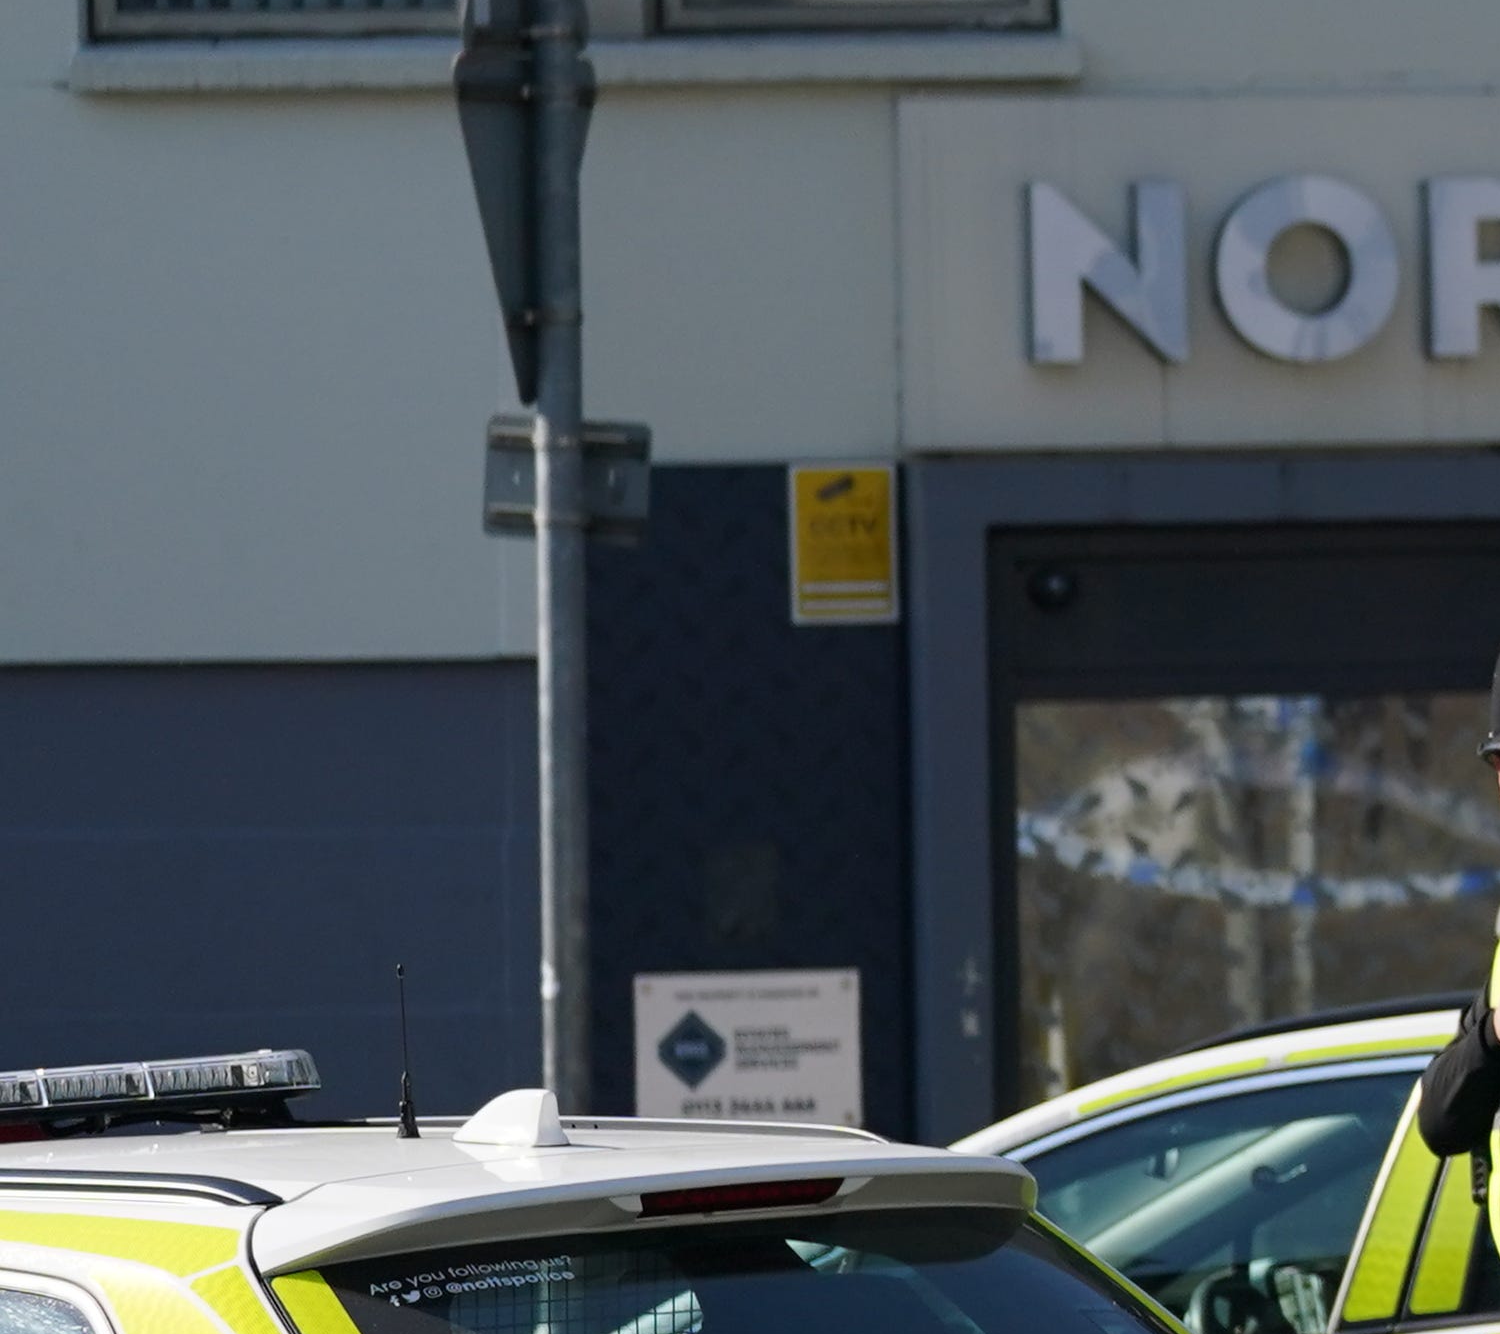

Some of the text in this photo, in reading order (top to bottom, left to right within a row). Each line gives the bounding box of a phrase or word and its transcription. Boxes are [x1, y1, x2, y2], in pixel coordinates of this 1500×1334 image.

[368, 1278, 403, 1297] Are
[406, 1270, 446, 1287] you
[446, 1257, 540, 1279] following
[445, 1270, 576, 1294] @nottspolice
